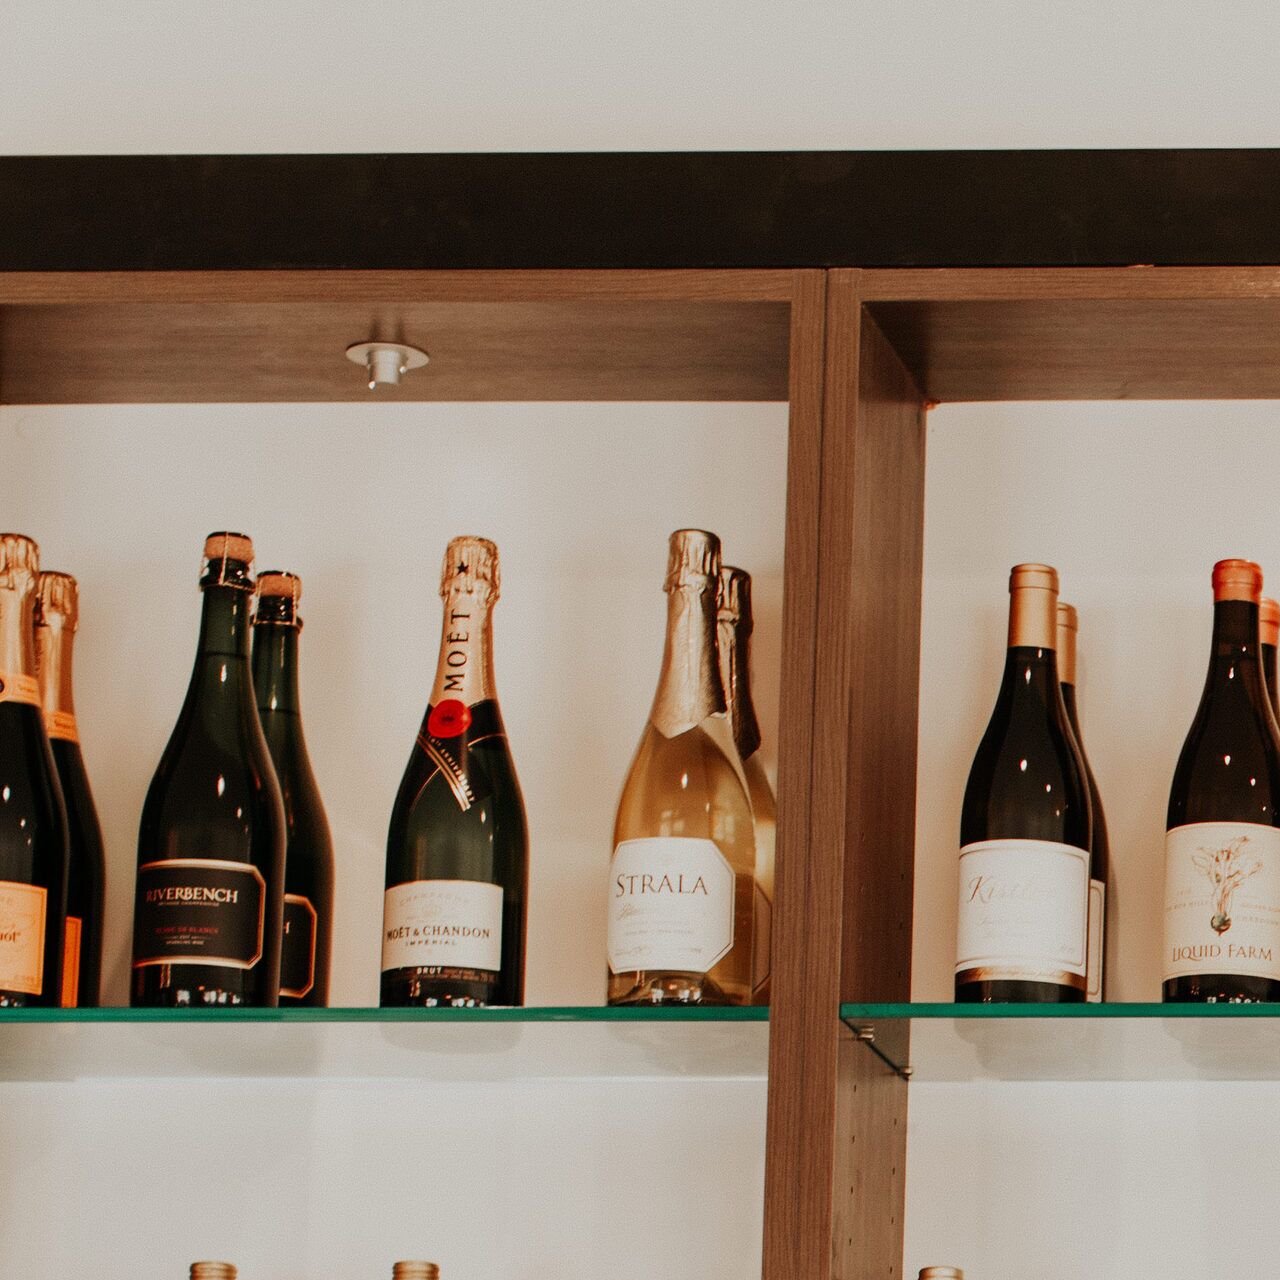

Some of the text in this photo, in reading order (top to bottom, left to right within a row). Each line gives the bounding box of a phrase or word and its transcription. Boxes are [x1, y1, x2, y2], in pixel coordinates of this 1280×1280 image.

[444, 608, 471, 691] MOËT
[147, 886, 239, 904] RIVERBENCH
[616, 872, 709, 898] STRALA
[412, 927, 420, 937] &
[422, 925, 491, 939] CHANDON
[1172, 943, 1273, 963] LIQUID FARM
